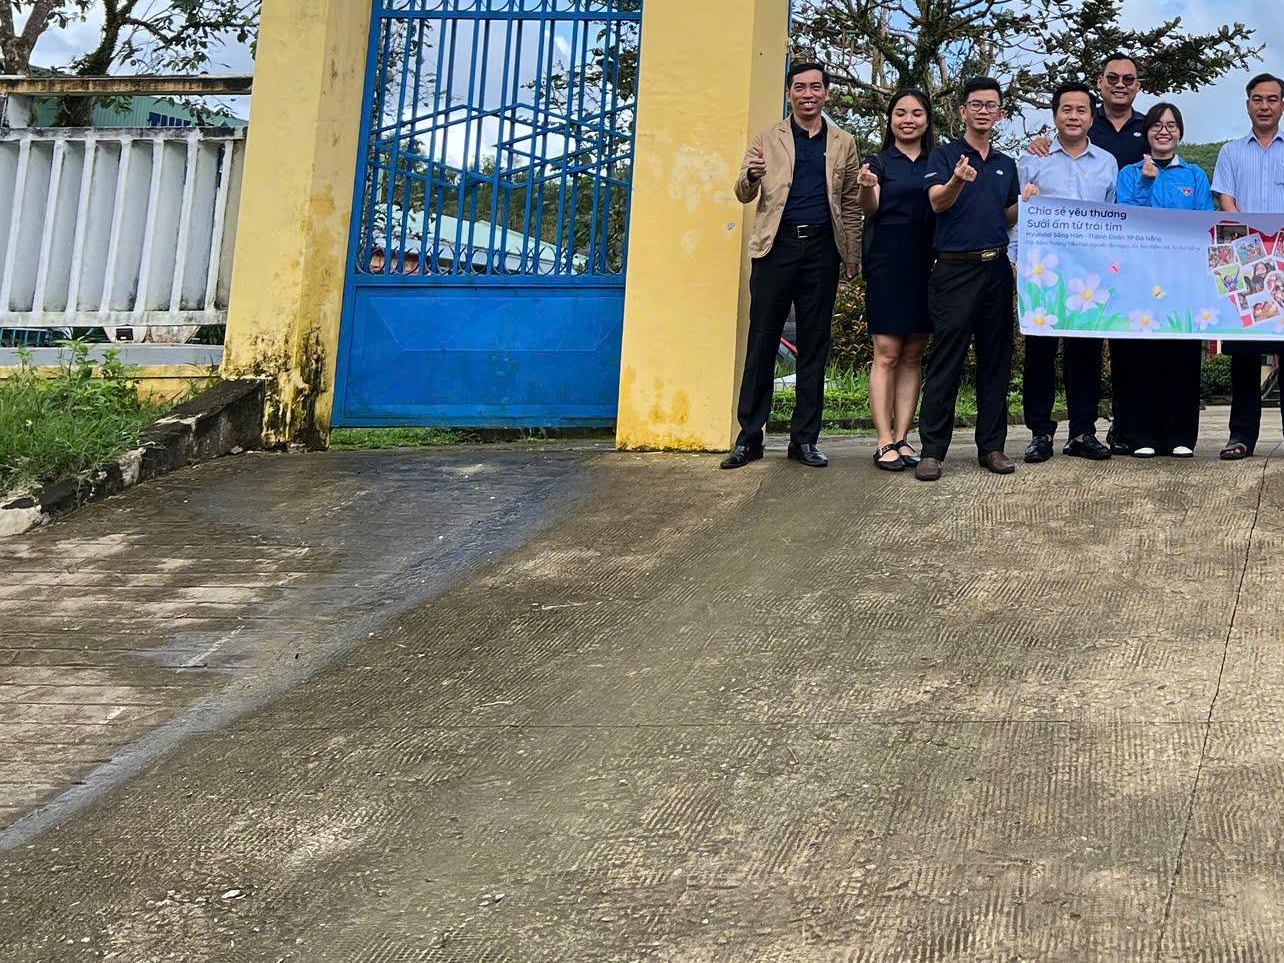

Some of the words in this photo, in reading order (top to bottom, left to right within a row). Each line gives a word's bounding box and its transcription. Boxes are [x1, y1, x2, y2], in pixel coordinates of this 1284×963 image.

[1027, 206, 1052, 216] Chia
[1068, 208, 1087, 218] yêu
[1089, 209, 1127, 221] thương
[1026, 219, 1050, 229] Sưởi
[1052, 219, 1070, 229] ấm
[1085, 222, 1103, 231] trái
[1105, 222, 1122, 232] tim
